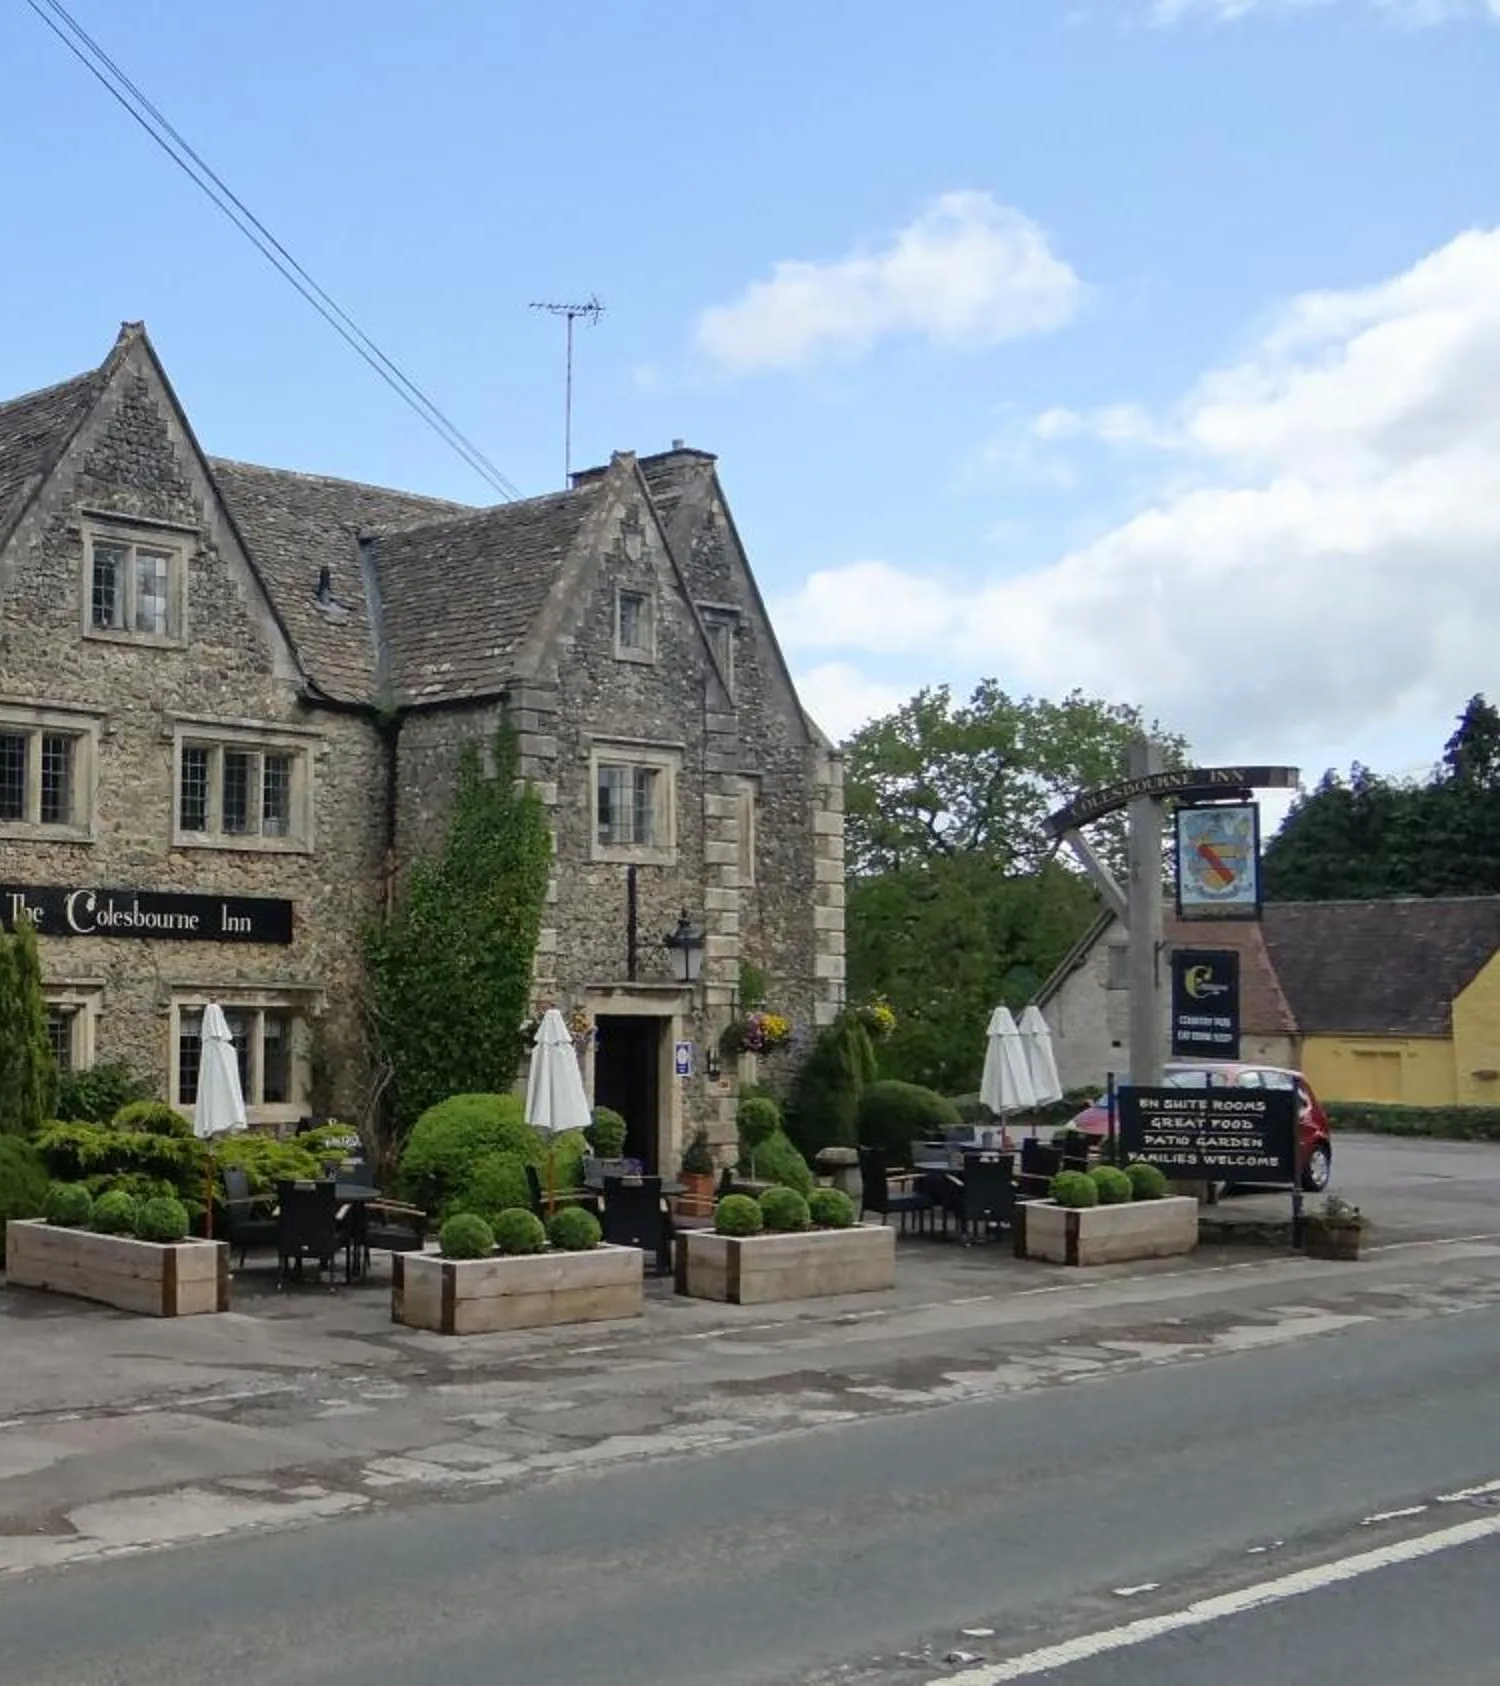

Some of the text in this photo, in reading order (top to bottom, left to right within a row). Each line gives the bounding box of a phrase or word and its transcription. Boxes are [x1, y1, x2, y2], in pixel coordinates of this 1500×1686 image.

[1209, 769, 1246, 784] INN
[5, 889, 252, 933] The Colesbourne Inn
[1139, 1098, 1267, 1112] EN SUITE ROOMS
[1151, 1117, 1254, 1129] GREAT FOOD
[1144, 1135, 1263, 1148] PATIO GARDEN
[1127, 1152, 1280, 1167] FAMILIES WELCOME
